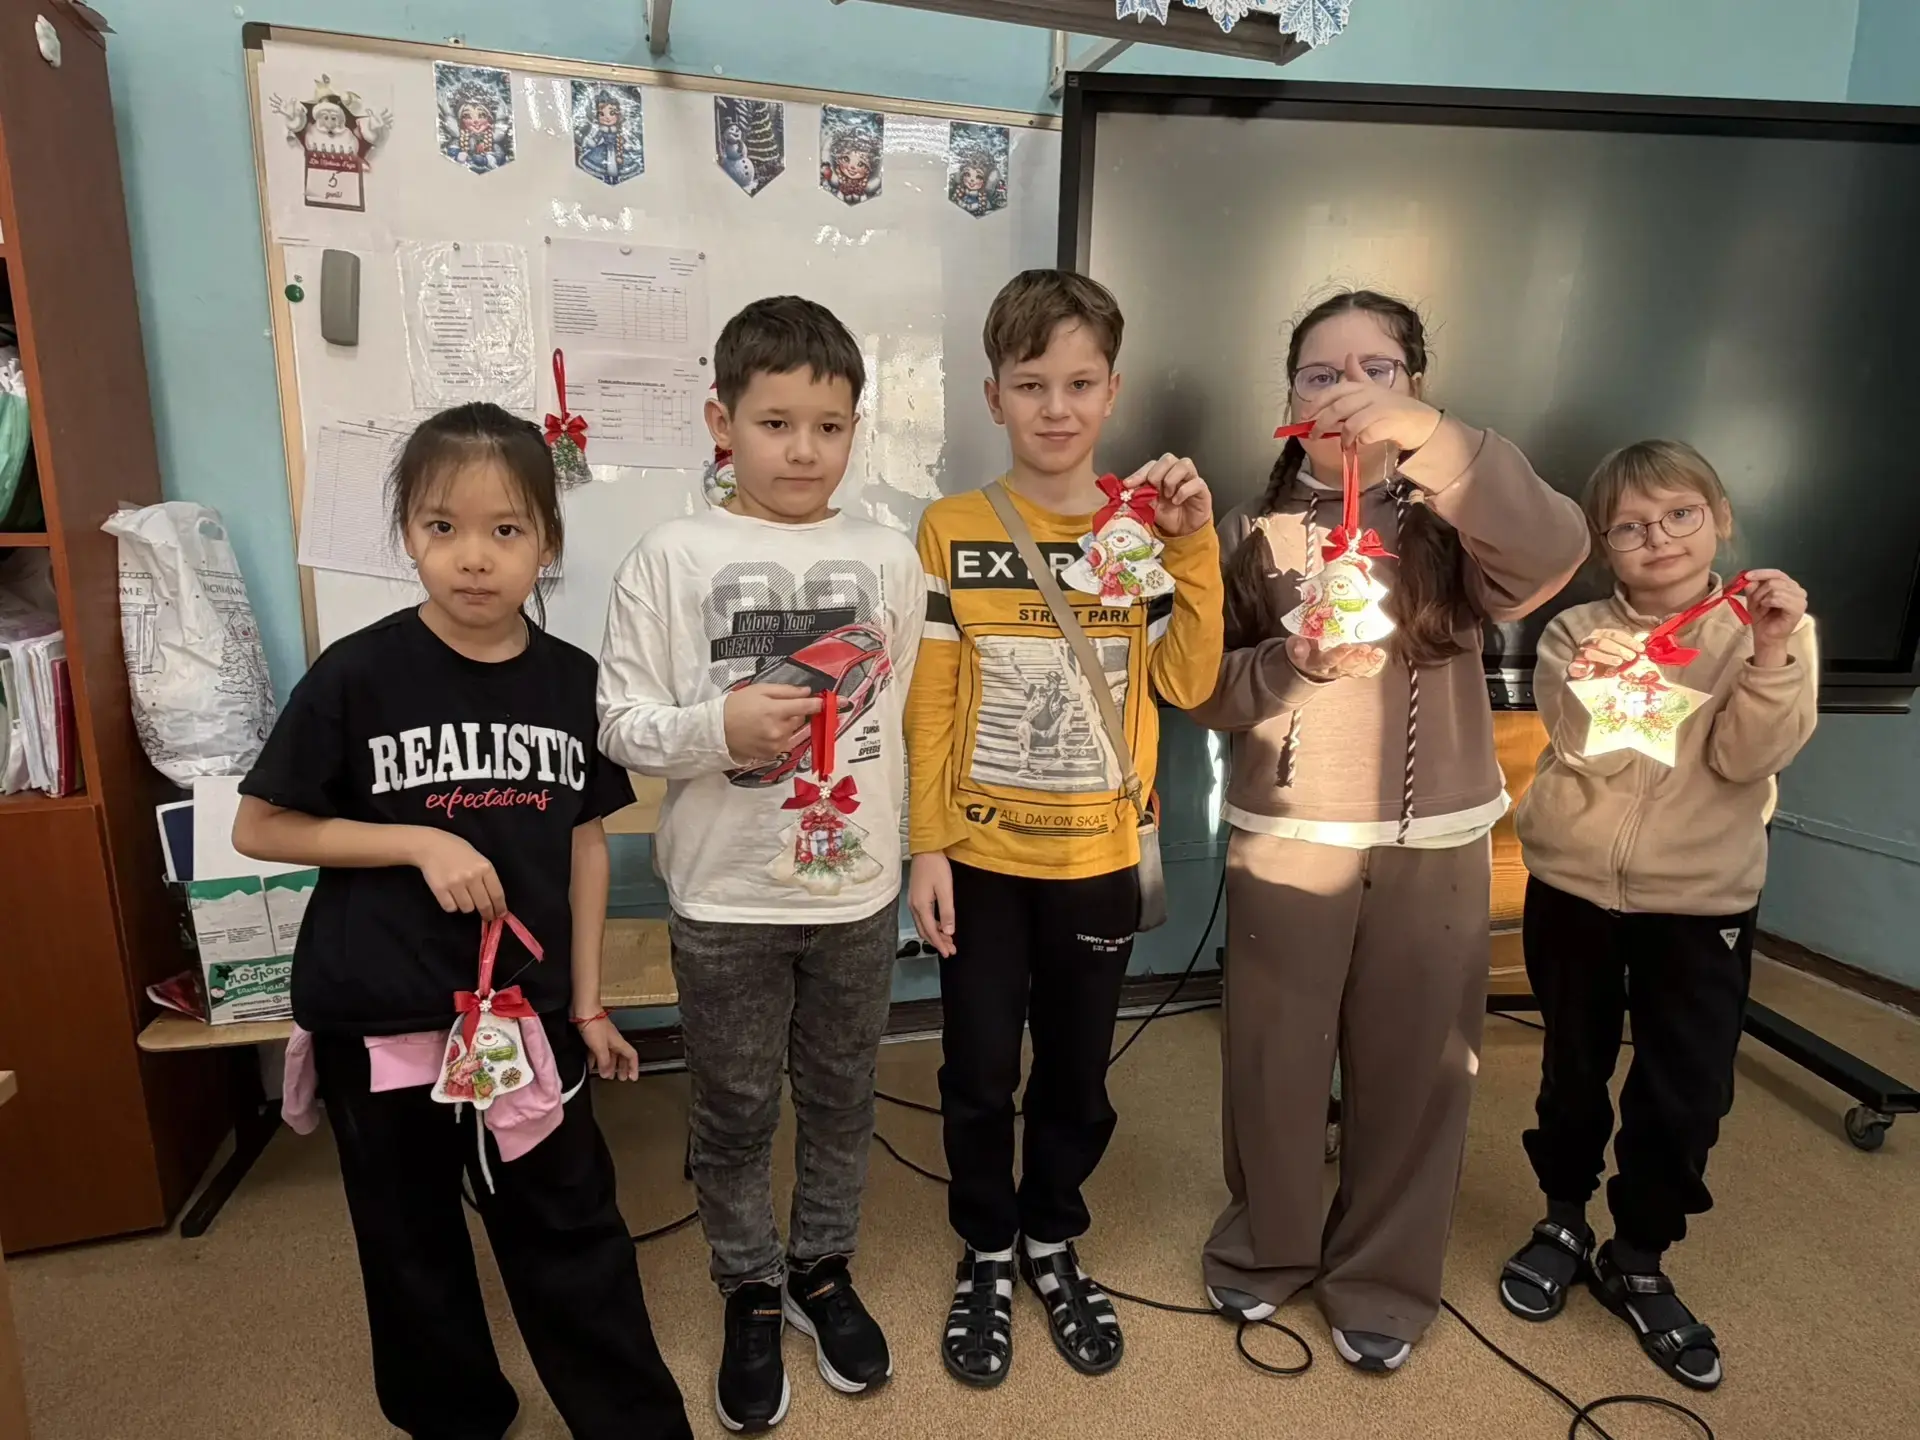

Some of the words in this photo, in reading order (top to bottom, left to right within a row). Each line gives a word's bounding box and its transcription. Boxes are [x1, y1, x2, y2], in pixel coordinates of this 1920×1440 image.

[957, 550, 1078, 580] EXR
[738, 612, 780, 633] Move
[783, 613, 816, 632] Your
[1019, 609, 1082, 623] STRT
[1088, 609, 1130, 623] PARK
[717, 636, 774, 657] DREAMS
[368, 723, 585, 794] REALISTIC
[425, 786, 553, 818] expectations
[965, 803, 997, 825] GJ
[1000, 809, 1020, 823] ALL
[1025, 813, 1051, 826] DAY
[1053, 815, 1073, 827] ON
